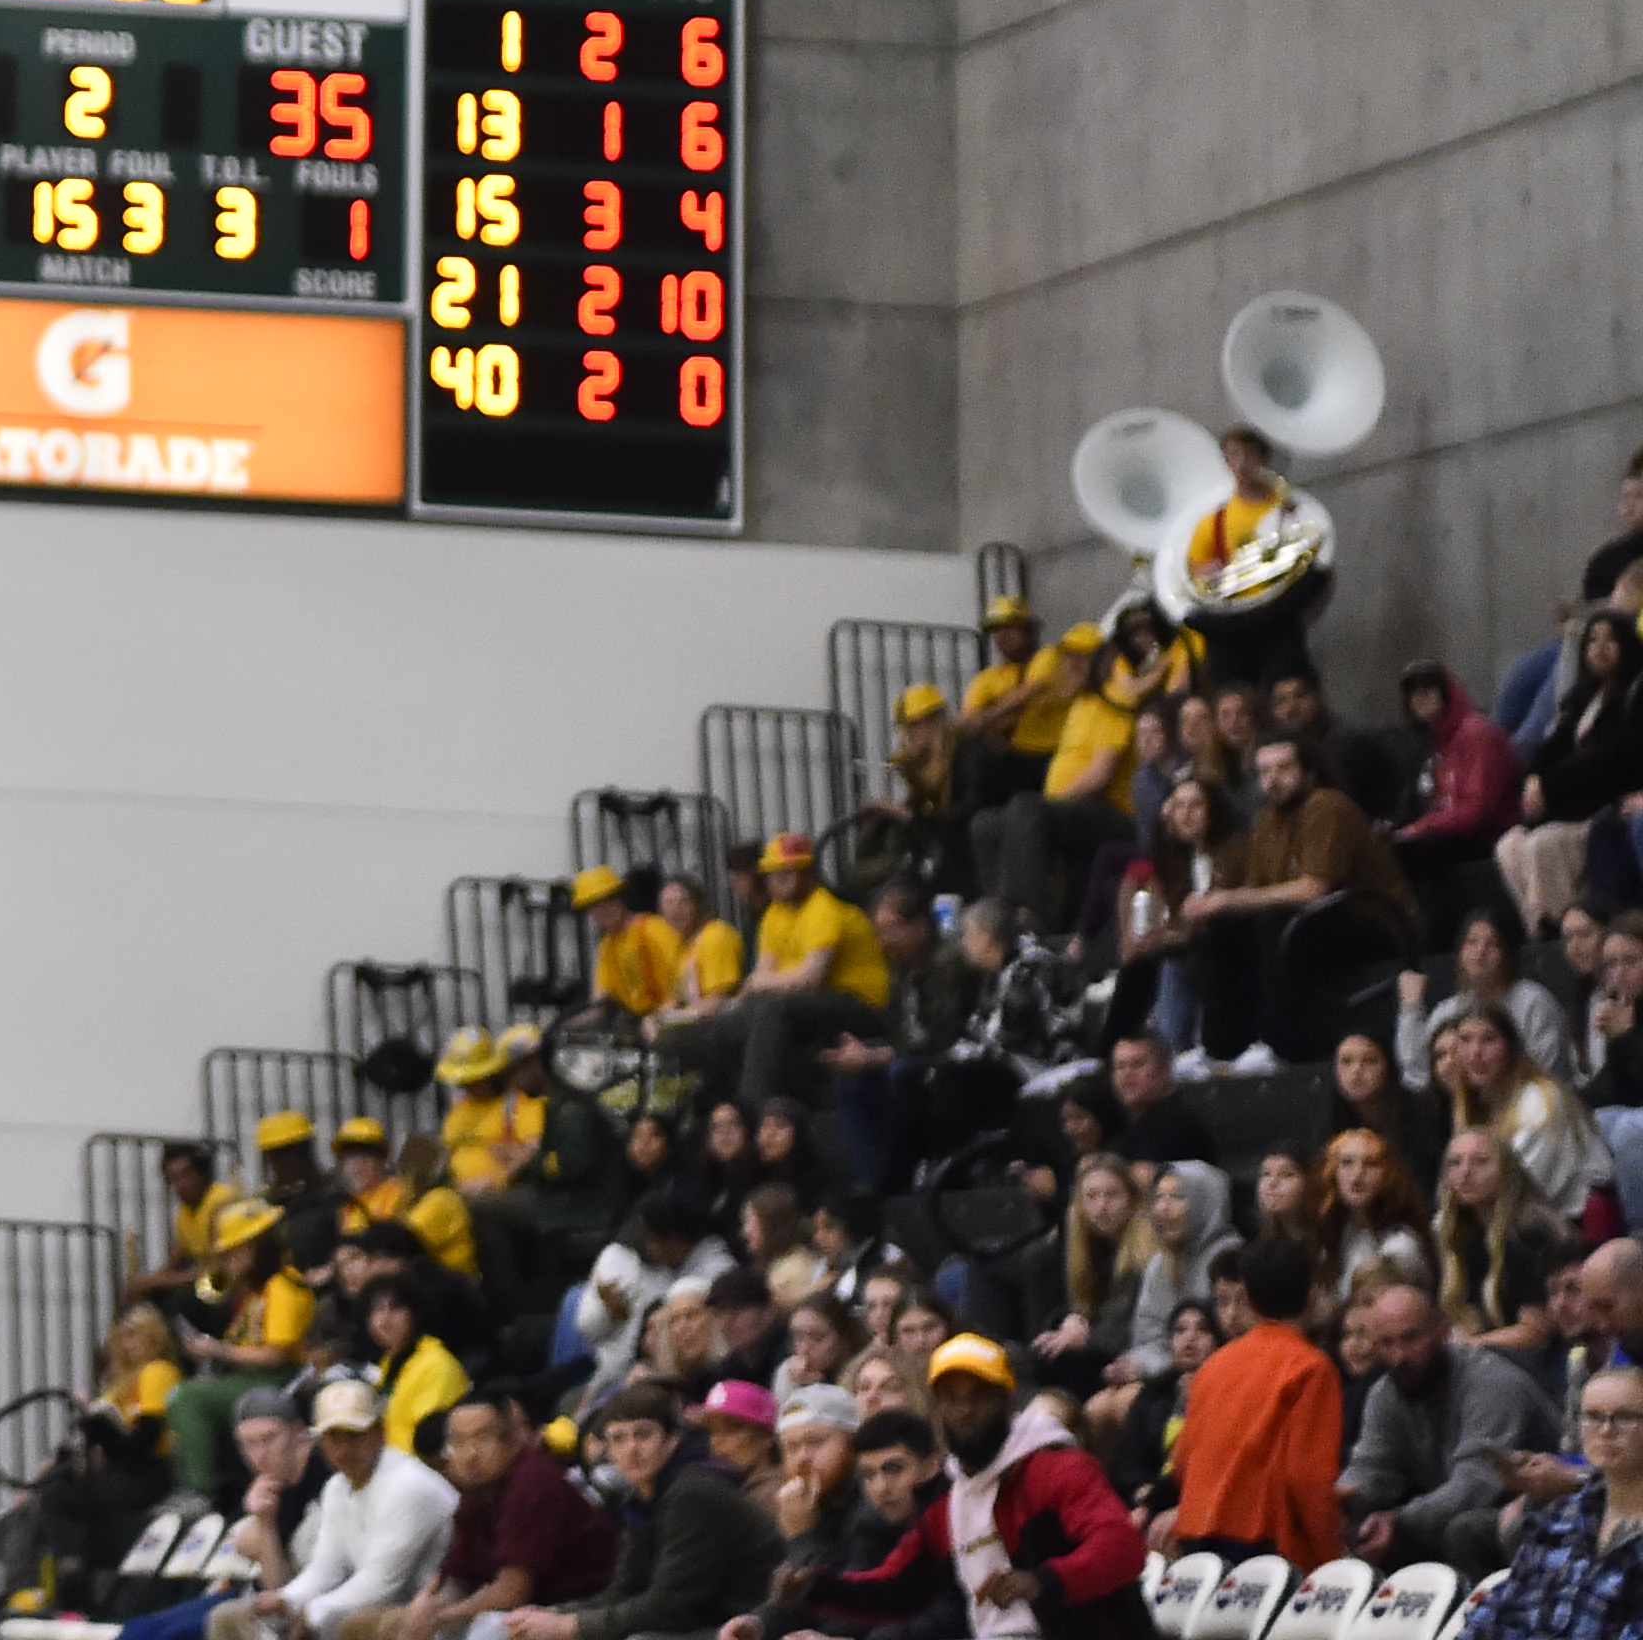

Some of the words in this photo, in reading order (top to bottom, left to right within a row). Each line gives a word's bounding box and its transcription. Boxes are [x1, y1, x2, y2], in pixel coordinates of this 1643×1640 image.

[42, 29, 136, 60] PERIOD
[245, 19, 368, 61] GUEST
[501, 10, 523, 73] 1
[579, 11, 624, 82] 2
[681, 16, 725, 88] 6
[64, 66, 112, 139] 2
[269, 69, 372, 161] 35
[456, 89, 522, 162] 13
[603, 100, 623, 162] 1
[680, 100, 724, 172] 6
[0, 144, 98, 176] PLAYER
[108, 149, 174, 180] FOUL
[294, 161, 379, 192] FOULS
[32, 178, 100, 251] 15
[122, 181, 165, 255] 3
[214, 186, 258, 260] 3
[349, 198, 370, 261] 1
[455, 174, 521, 247] 15
[583, 180, 622, 251] 3
[679, 189, 724, 252] 4
[40, 255, 131, 286] MATCH
[294, 270, 377, 300] SCORE
[430, 256, 521, 329] 21
[577, 264, 622, 336] 2
[660, 270, 724, 342] 10
[36, 309, 135, 418] G
[430, 343, 520, 417] 40
[577, 350, 622, 422] 2
[679, 355, 724, 427] 0
